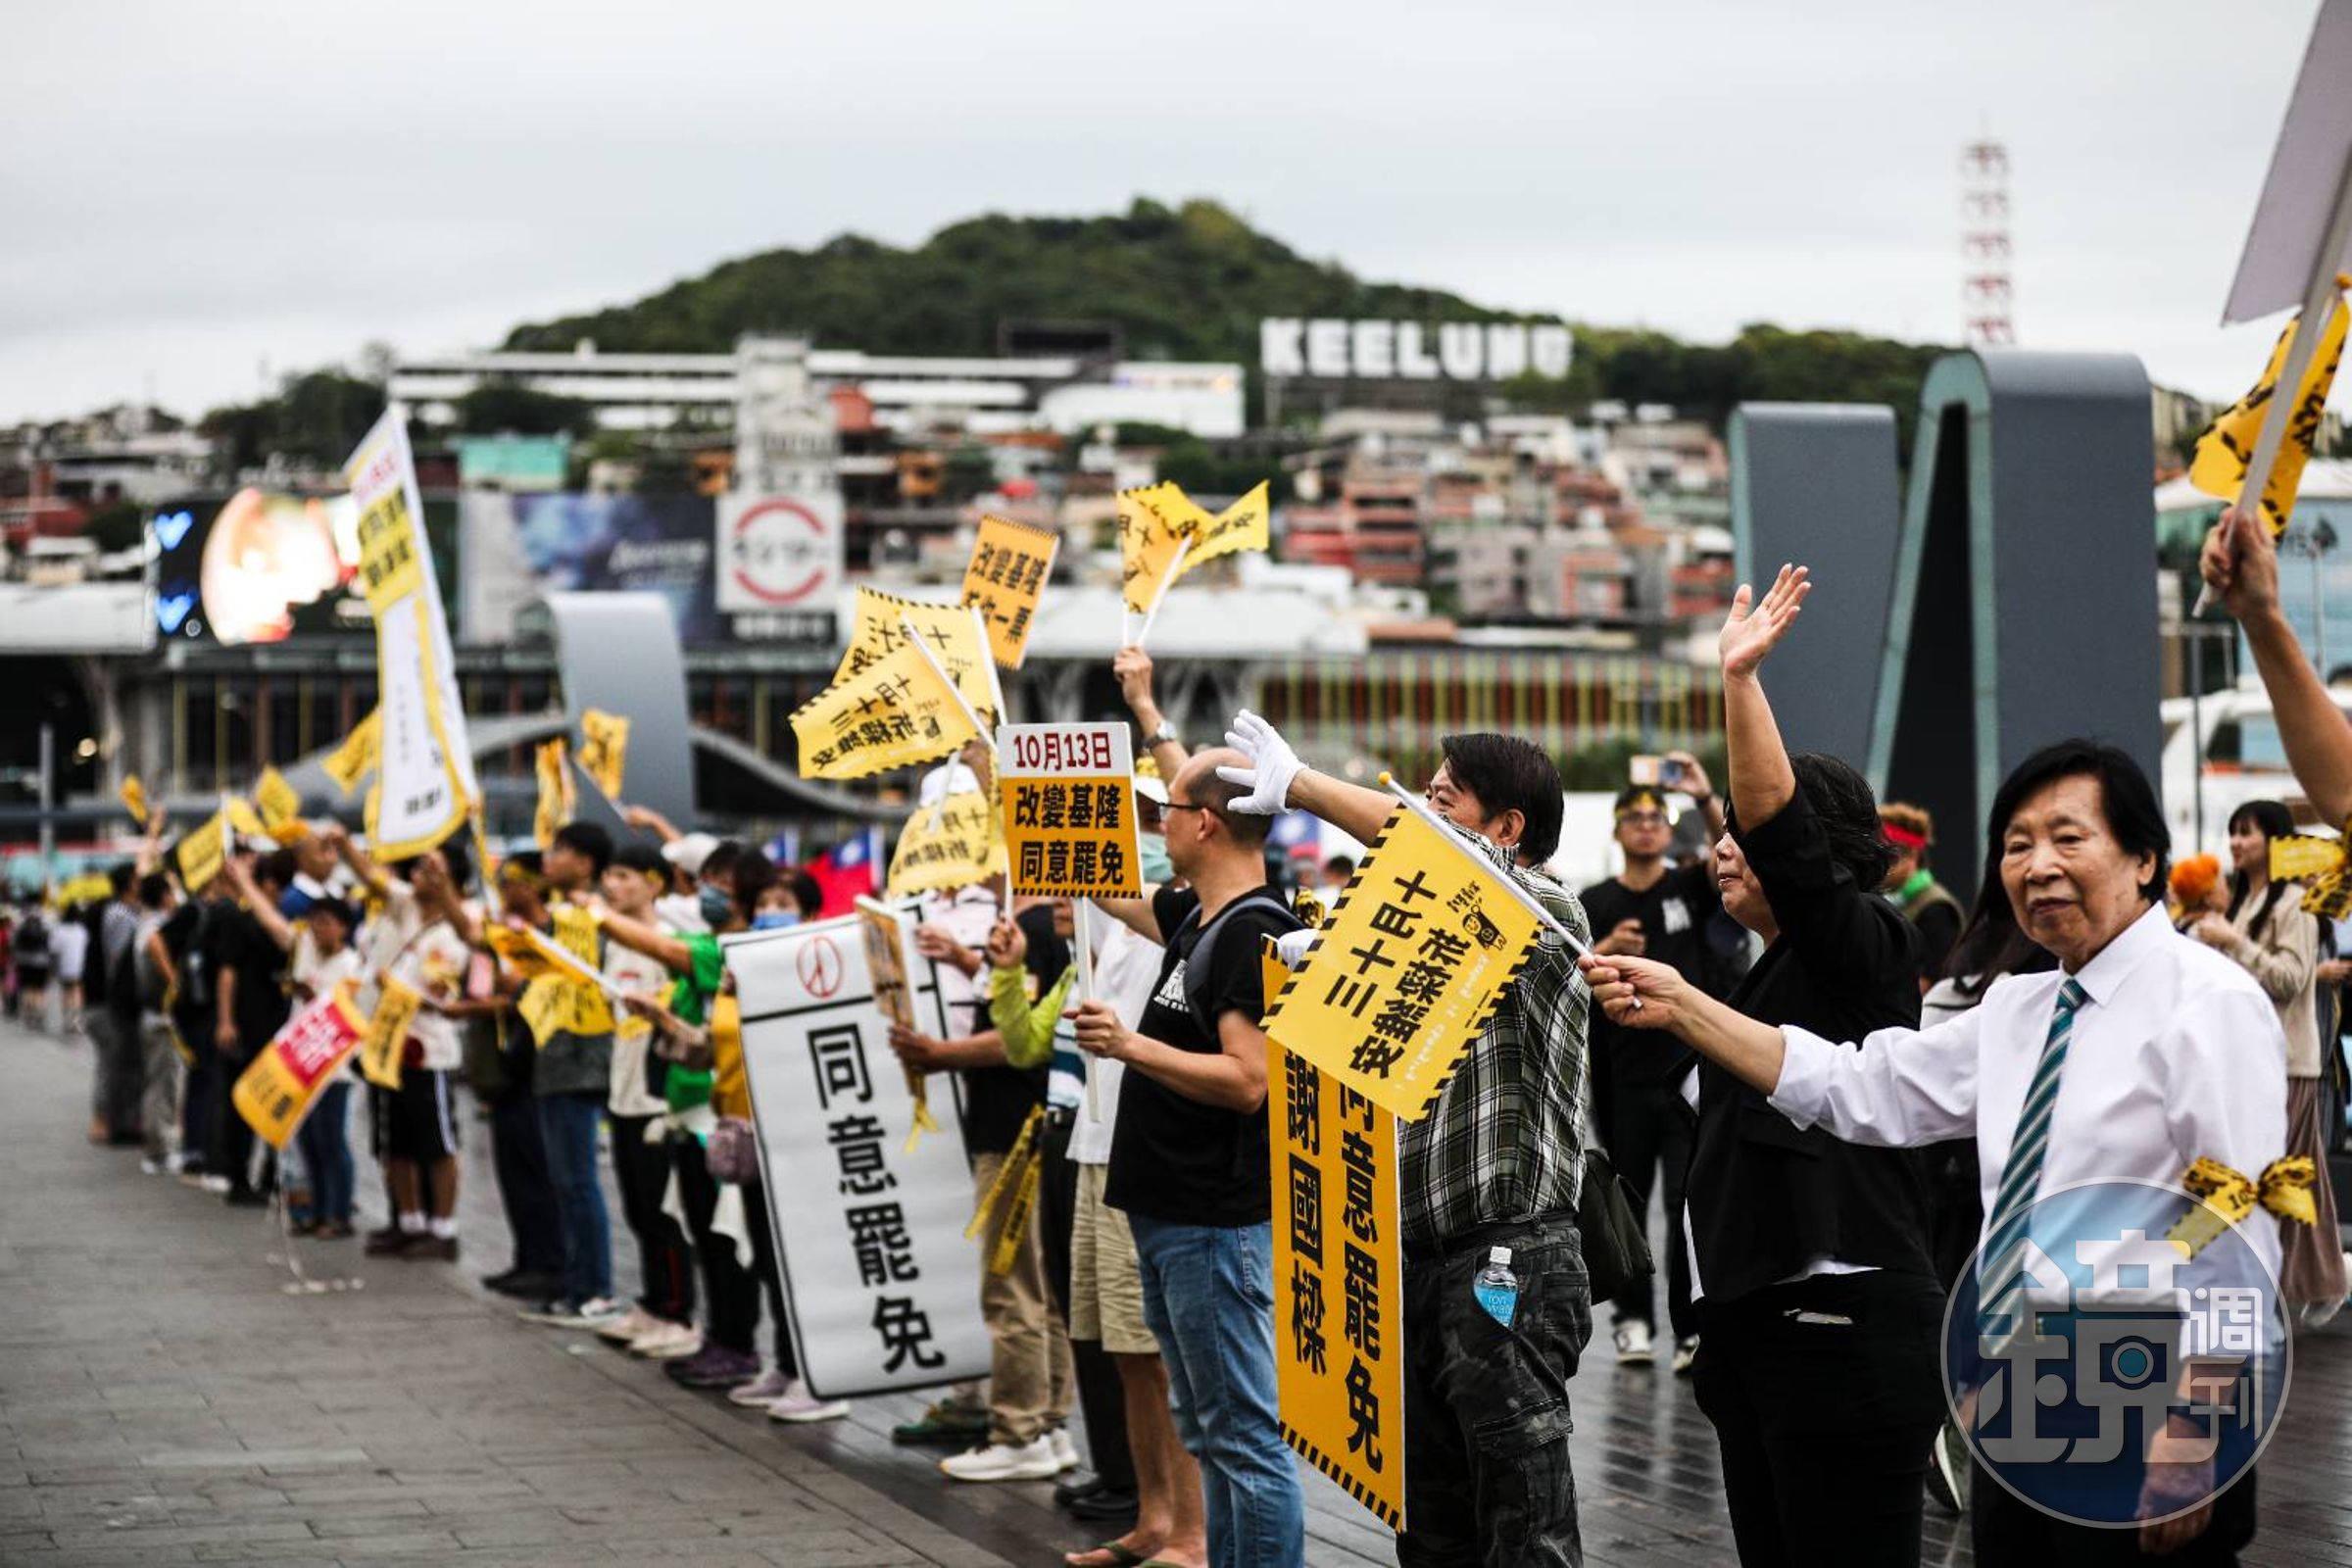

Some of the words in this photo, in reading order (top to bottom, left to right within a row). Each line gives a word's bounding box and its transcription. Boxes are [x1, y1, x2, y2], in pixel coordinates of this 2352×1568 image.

[1261, 318, 1574, 380] KEELUNG
[1013, 731, 1112, 770] 10月13日
[1014, 783, 1121, 831] 改變基隆
[1018, 840, 1125, 886] 同意罷免
[807, 1022, 946, 1374] 同意罷免
[1284, 1048, 1327, 1376] 謝國樑
